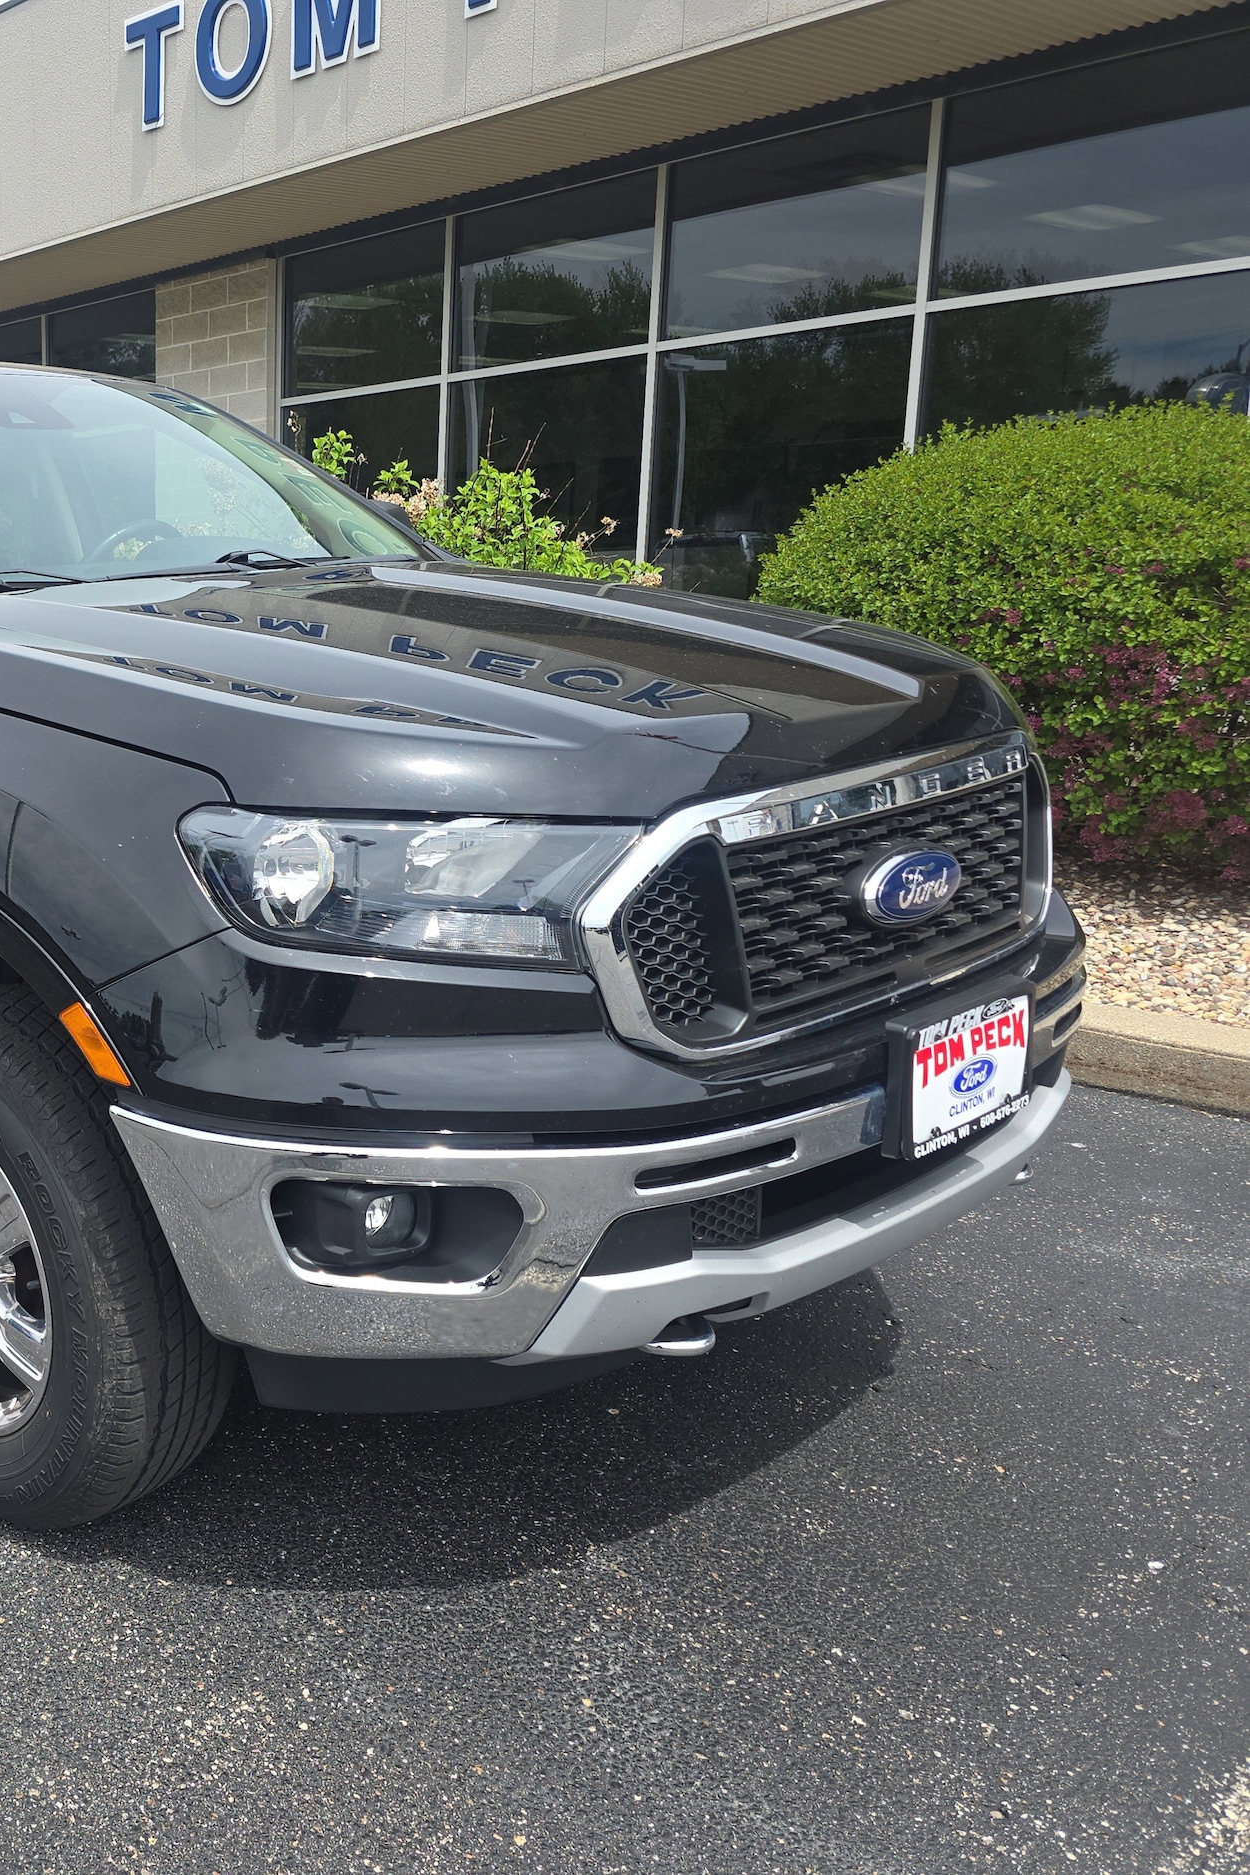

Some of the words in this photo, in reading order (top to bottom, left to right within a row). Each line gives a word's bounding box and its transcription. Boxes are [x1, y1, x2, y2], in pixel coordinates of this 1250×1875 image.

[124, 0, 381, 131] TOM
[898, 861, 949, 910] Ford
[948, 1004, 986, 1037] PECK
[915, 1033, 965, 1089] TOM
[970, 1008, 1025, 1056] PECK
[960, 1062, 989, 1090] Ford
[949, 1092, 985, 1117] CLINTON,
[986, 1086, 996, 1100] WI
[914, 1130, 958, 1159] CLINTON,
[957, 1123, 970, 1140] WI
[16, 1150, 87, 1323] ROCKY
[14, 1325, 90, 1505] MOUNTAIN
